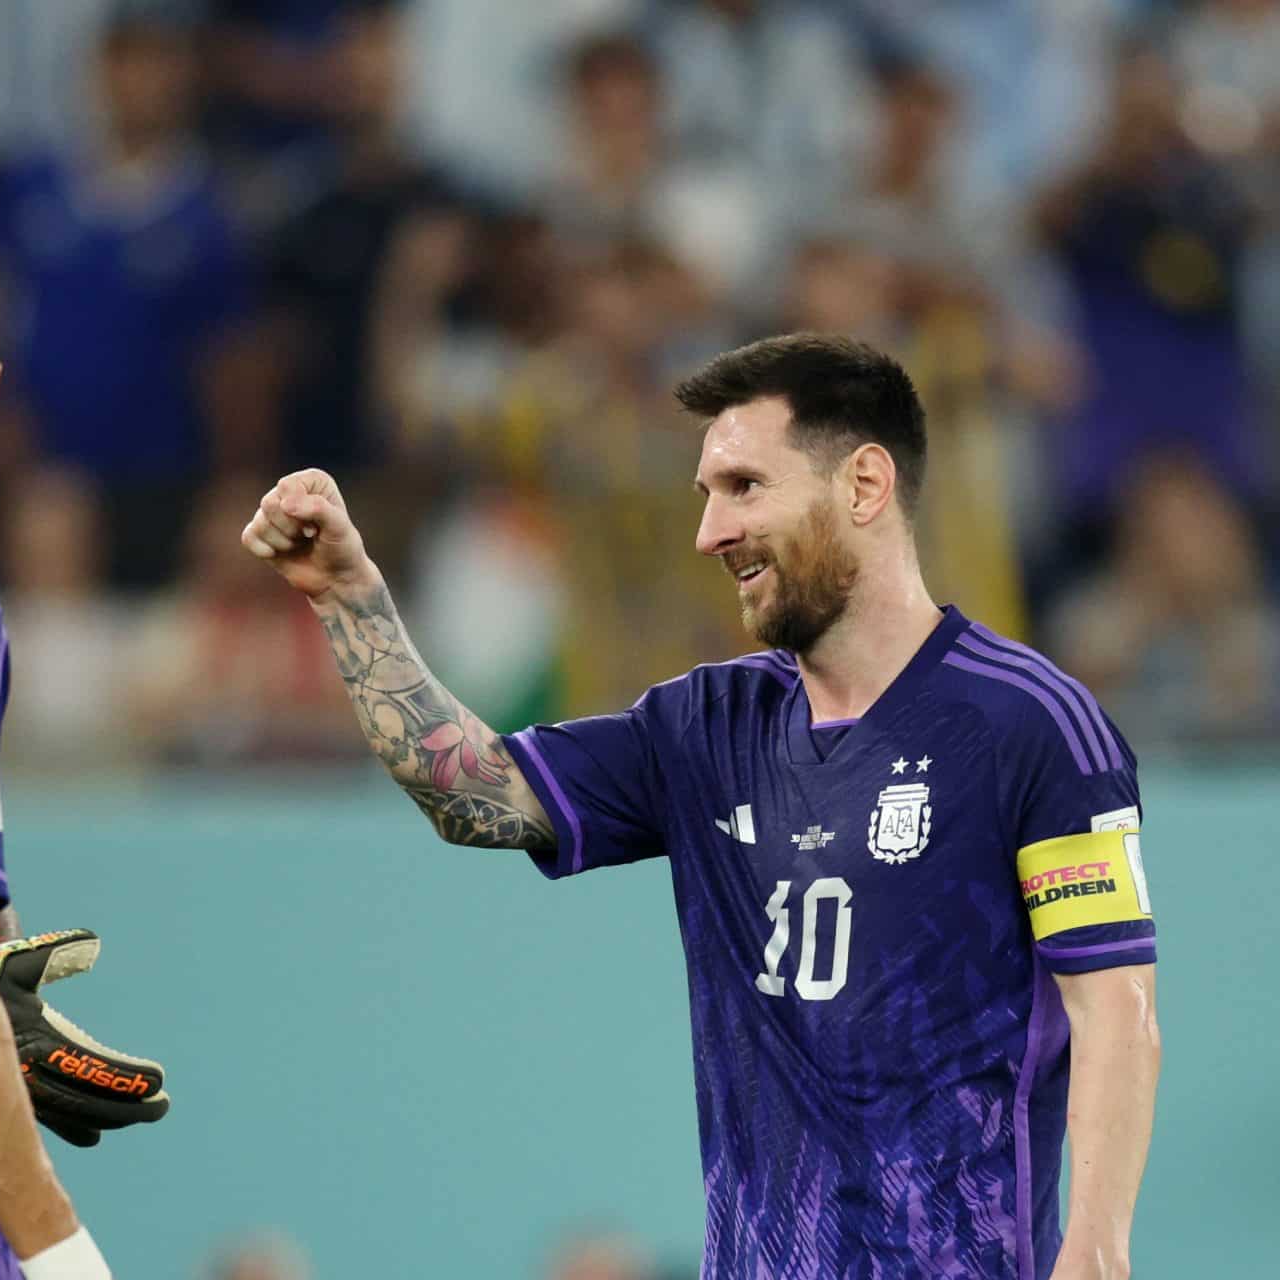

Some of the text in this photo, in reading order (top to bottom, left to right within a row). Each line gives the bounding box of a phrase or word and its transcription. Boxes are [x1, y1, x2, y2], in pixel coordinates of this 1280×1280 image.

[882, 805, 915, 840] AFA
[1019, 861, 1111, 895] ROTECT
[1024, 878, 1117, 912] HILDREN
[755, 877, 853, 1001] 10
[47, 1048, 150, 1096] reusch
